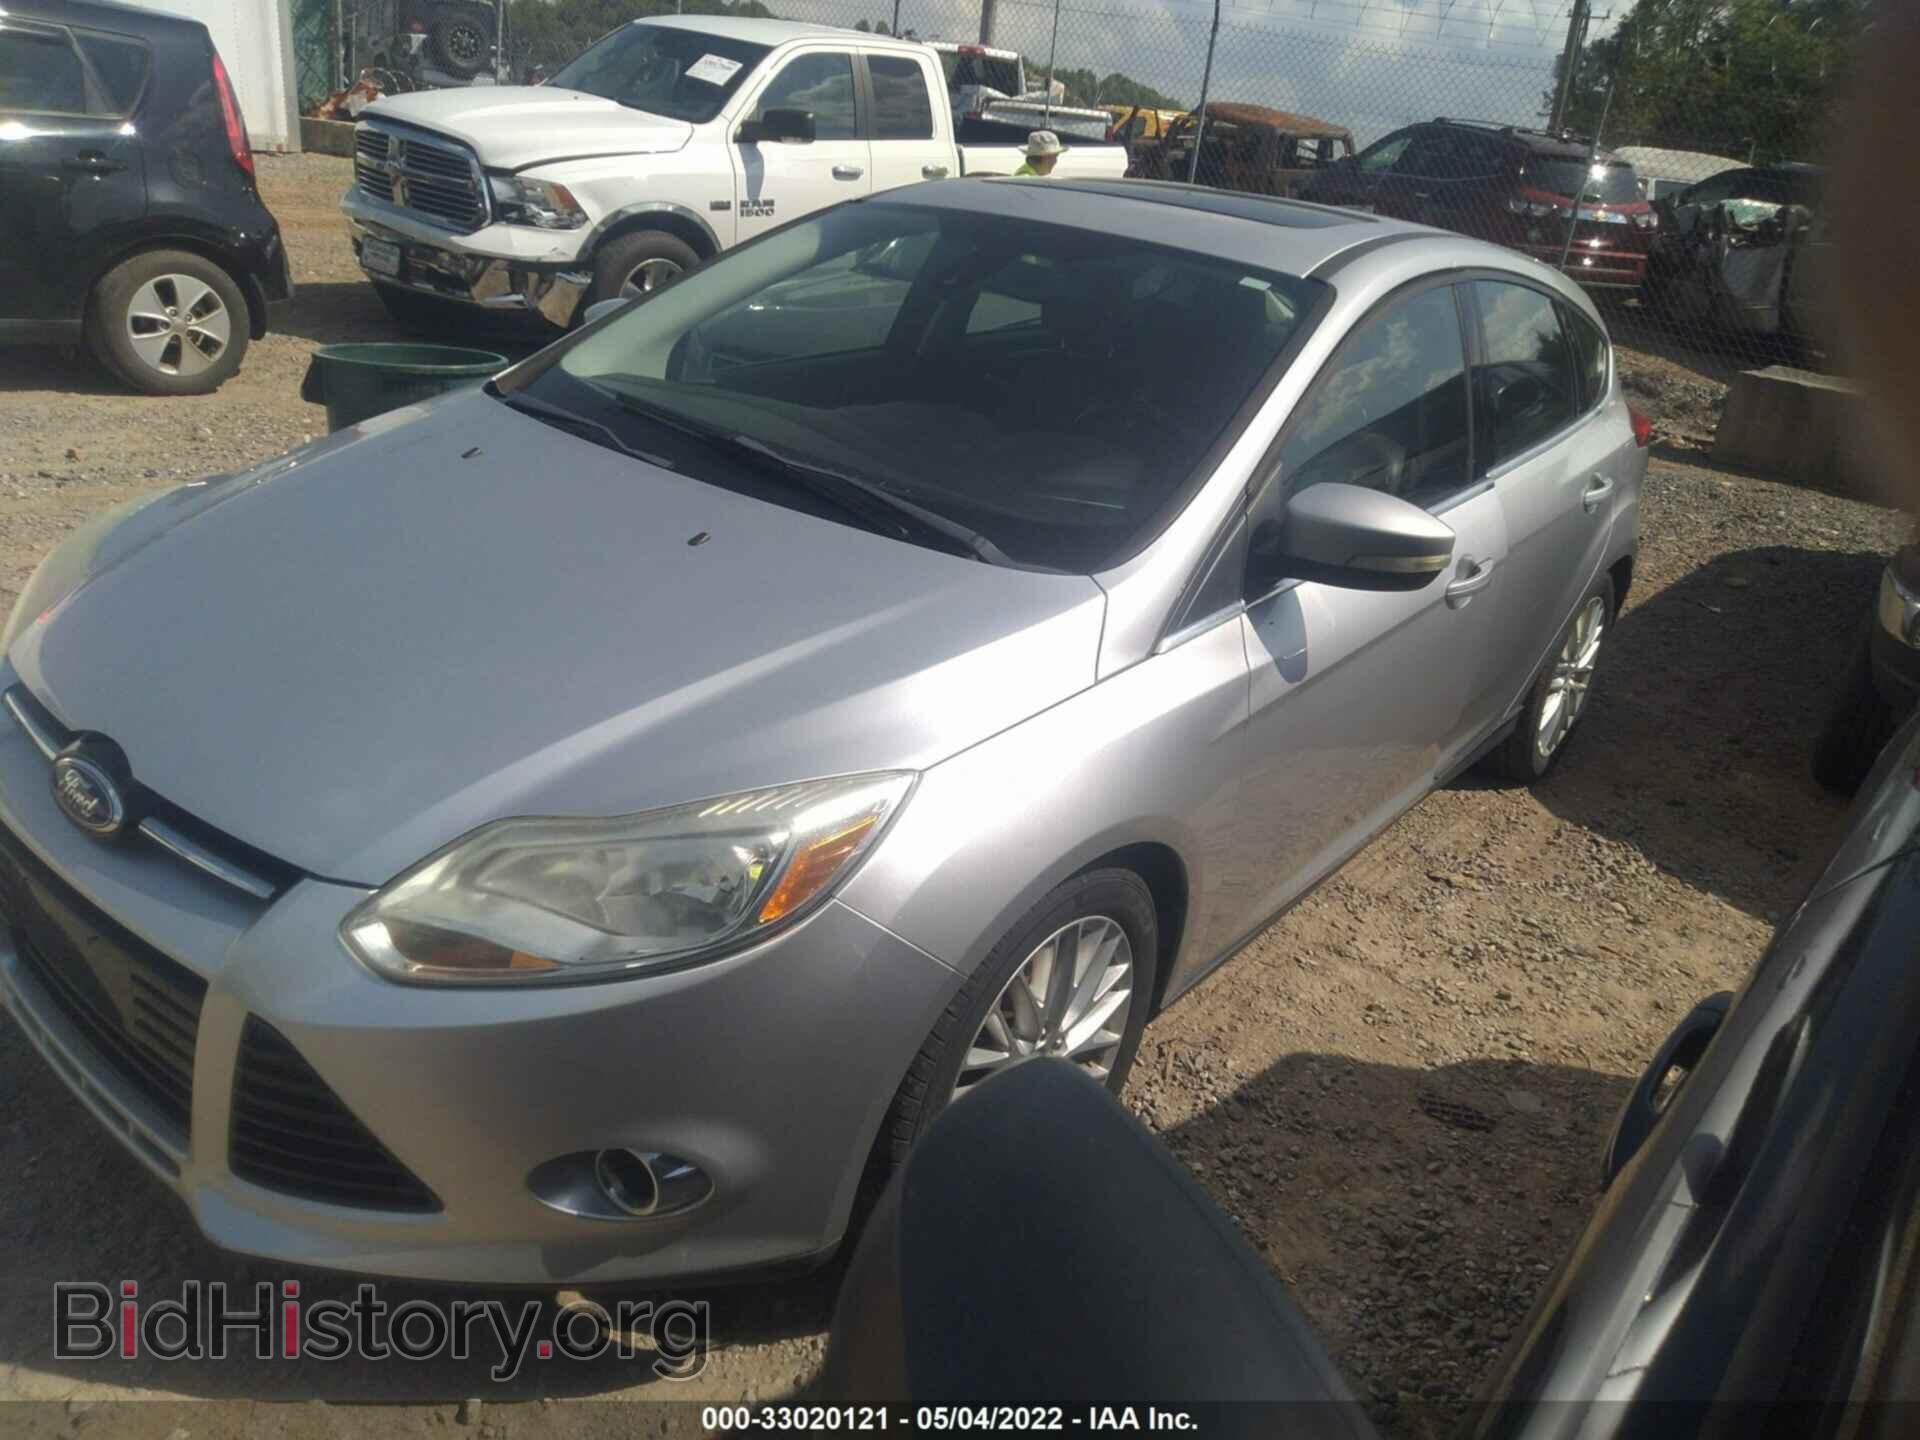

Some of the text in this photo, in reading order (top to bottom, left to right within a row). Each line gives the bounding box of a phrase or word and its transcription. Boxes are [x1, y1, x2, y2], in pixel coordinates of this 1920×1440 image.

[740, 200, 774, 208] RAM
[740, 208, 774, 217] 1500
[63, 768, 99, 818] Ford
